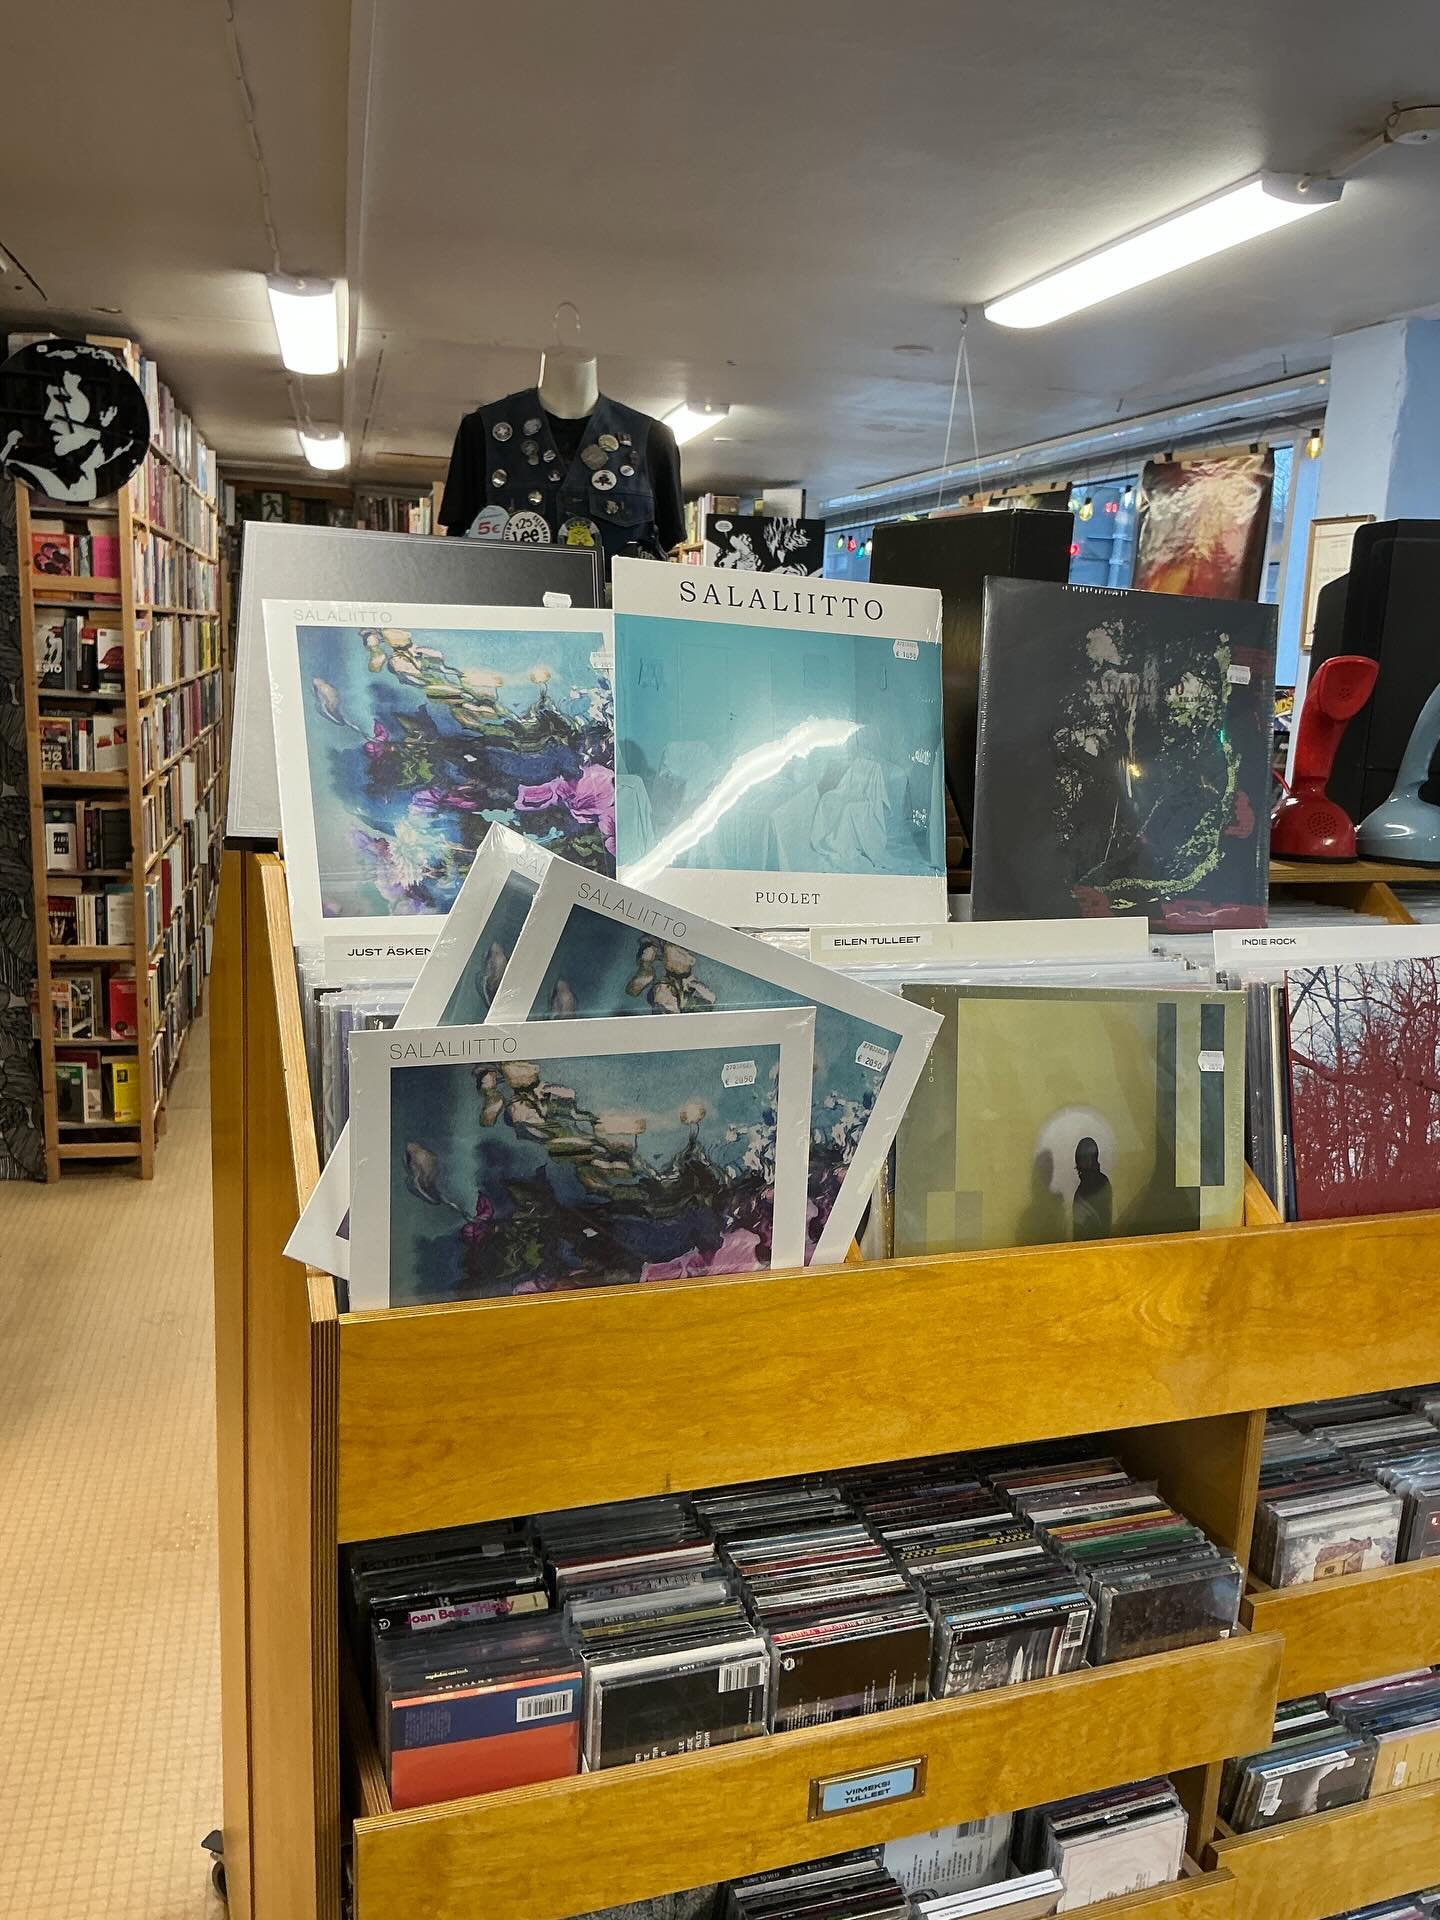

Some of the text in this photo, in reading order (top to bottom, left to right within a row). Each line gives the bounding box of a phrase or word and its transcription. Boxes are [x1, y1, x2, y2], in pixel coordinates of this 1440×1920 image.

[680, 580, 884, 621] SALALIITTO
[294, 608, 393, 624] SALALIITTO
[755, 891, 821, 905] PUOLET
[577, 882, 688, 938] SALALIITTO
[834, 936, 921, 947] EILEN TULLEET
[1242, 938, 1268, 946] INDIE
[347, 948, 383, 957] JUST
[390, 1037, 518, 1060] SALALIITTO
[407, 1612, 436, 1626] Joan
[438, 1606, 471, 1619] Baez
[844, 1788, 891, 1803] TULLEET
[845, 1780, 891, 1796] VIIMEKSI
